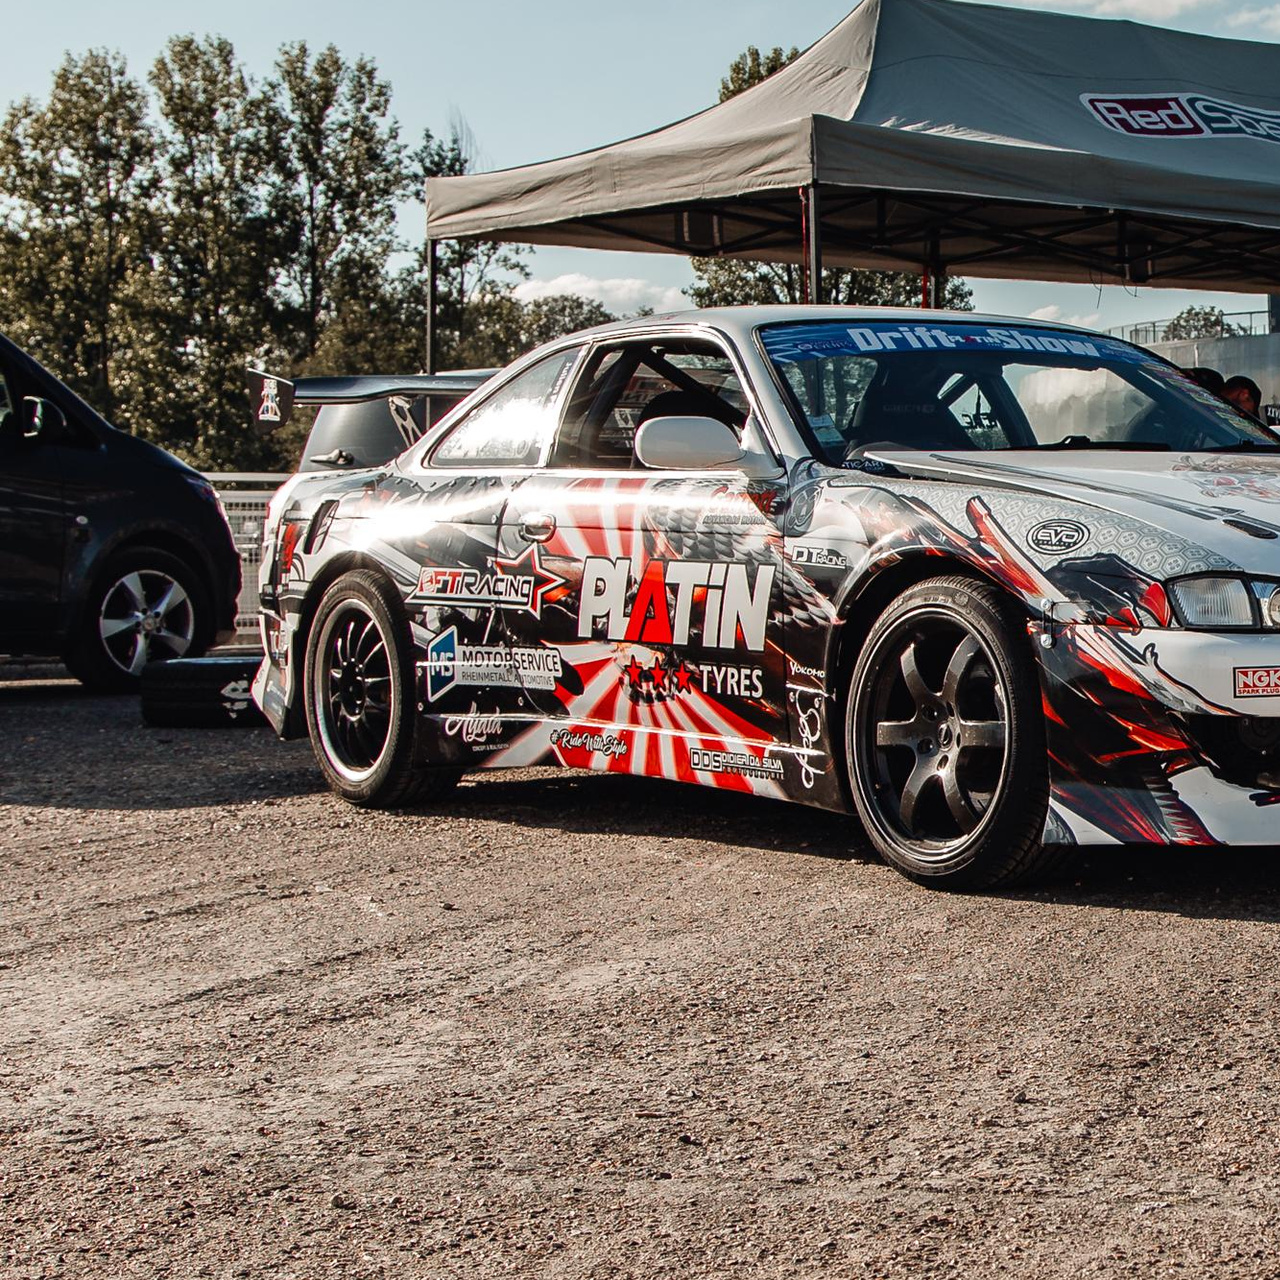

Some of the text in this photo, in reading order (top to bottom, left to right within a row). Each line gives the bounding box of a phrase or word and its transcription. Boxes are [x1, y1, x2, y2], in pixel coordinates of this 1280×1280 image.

[1094, 101, 1195, 129] Red
[847, 326, 957, 351] Drift
[986, 329, 1101, 357] Show
[431, 651, 454, 677] MS
[461, 650, 560, 673] MOTORSERVICE
[789, 661, 826, 678] YOKOMO
[461, 671, 553, 686] RHEINMETALL AUTOMOTIVE
[700, 664, 763, 698] TYRES
[549, 728, 628, 760] #RideWithStyle
[691, 749, 722, 772] DDS
[722, 752, 784, 772] DIDIER DA SILVA
